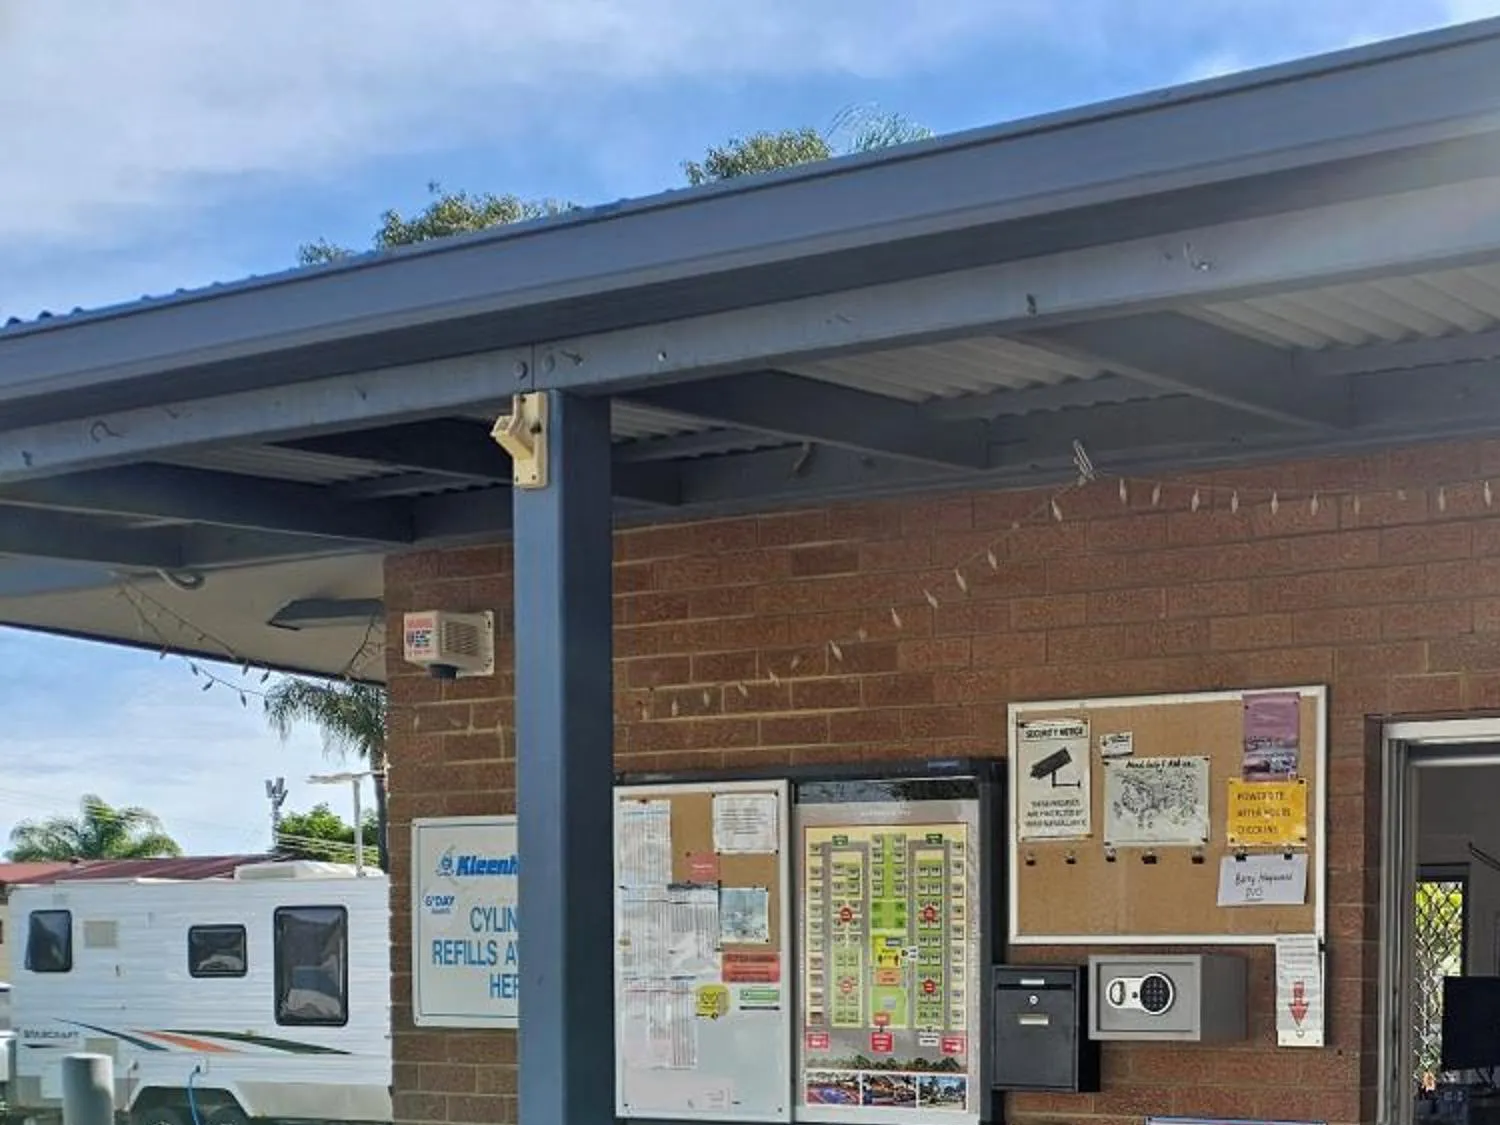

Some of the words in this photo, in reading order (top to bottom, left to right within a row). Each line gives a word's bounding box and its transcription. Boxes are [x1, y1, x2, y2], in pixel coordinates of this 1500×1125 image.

[425, 896, 455, 907] G'DAY
[432, 940, 498, 966] REFILLS
[505, 943, 518, 966] A
